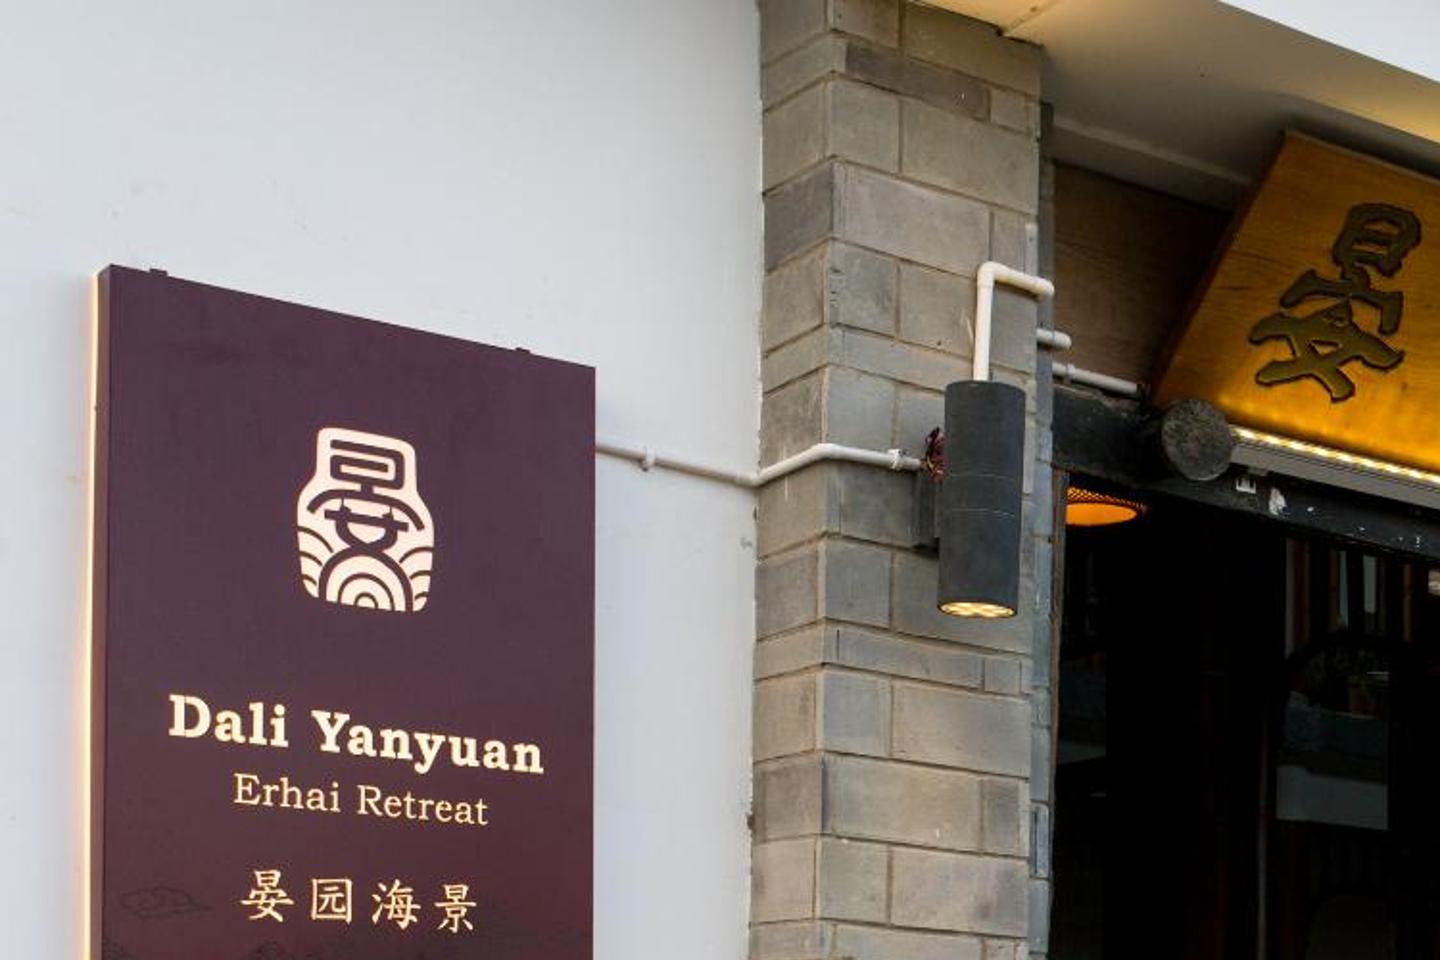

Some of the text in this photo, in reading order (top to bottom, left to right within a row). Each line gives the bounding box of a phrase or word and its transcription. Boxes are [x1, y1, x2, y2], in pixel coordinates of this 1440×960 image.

[168, 693, 545, 775] Dali Yanyuan
[233, 772, 489, 826] Erhai Retreat
[240, 869, 477, 934] 晏园海景
